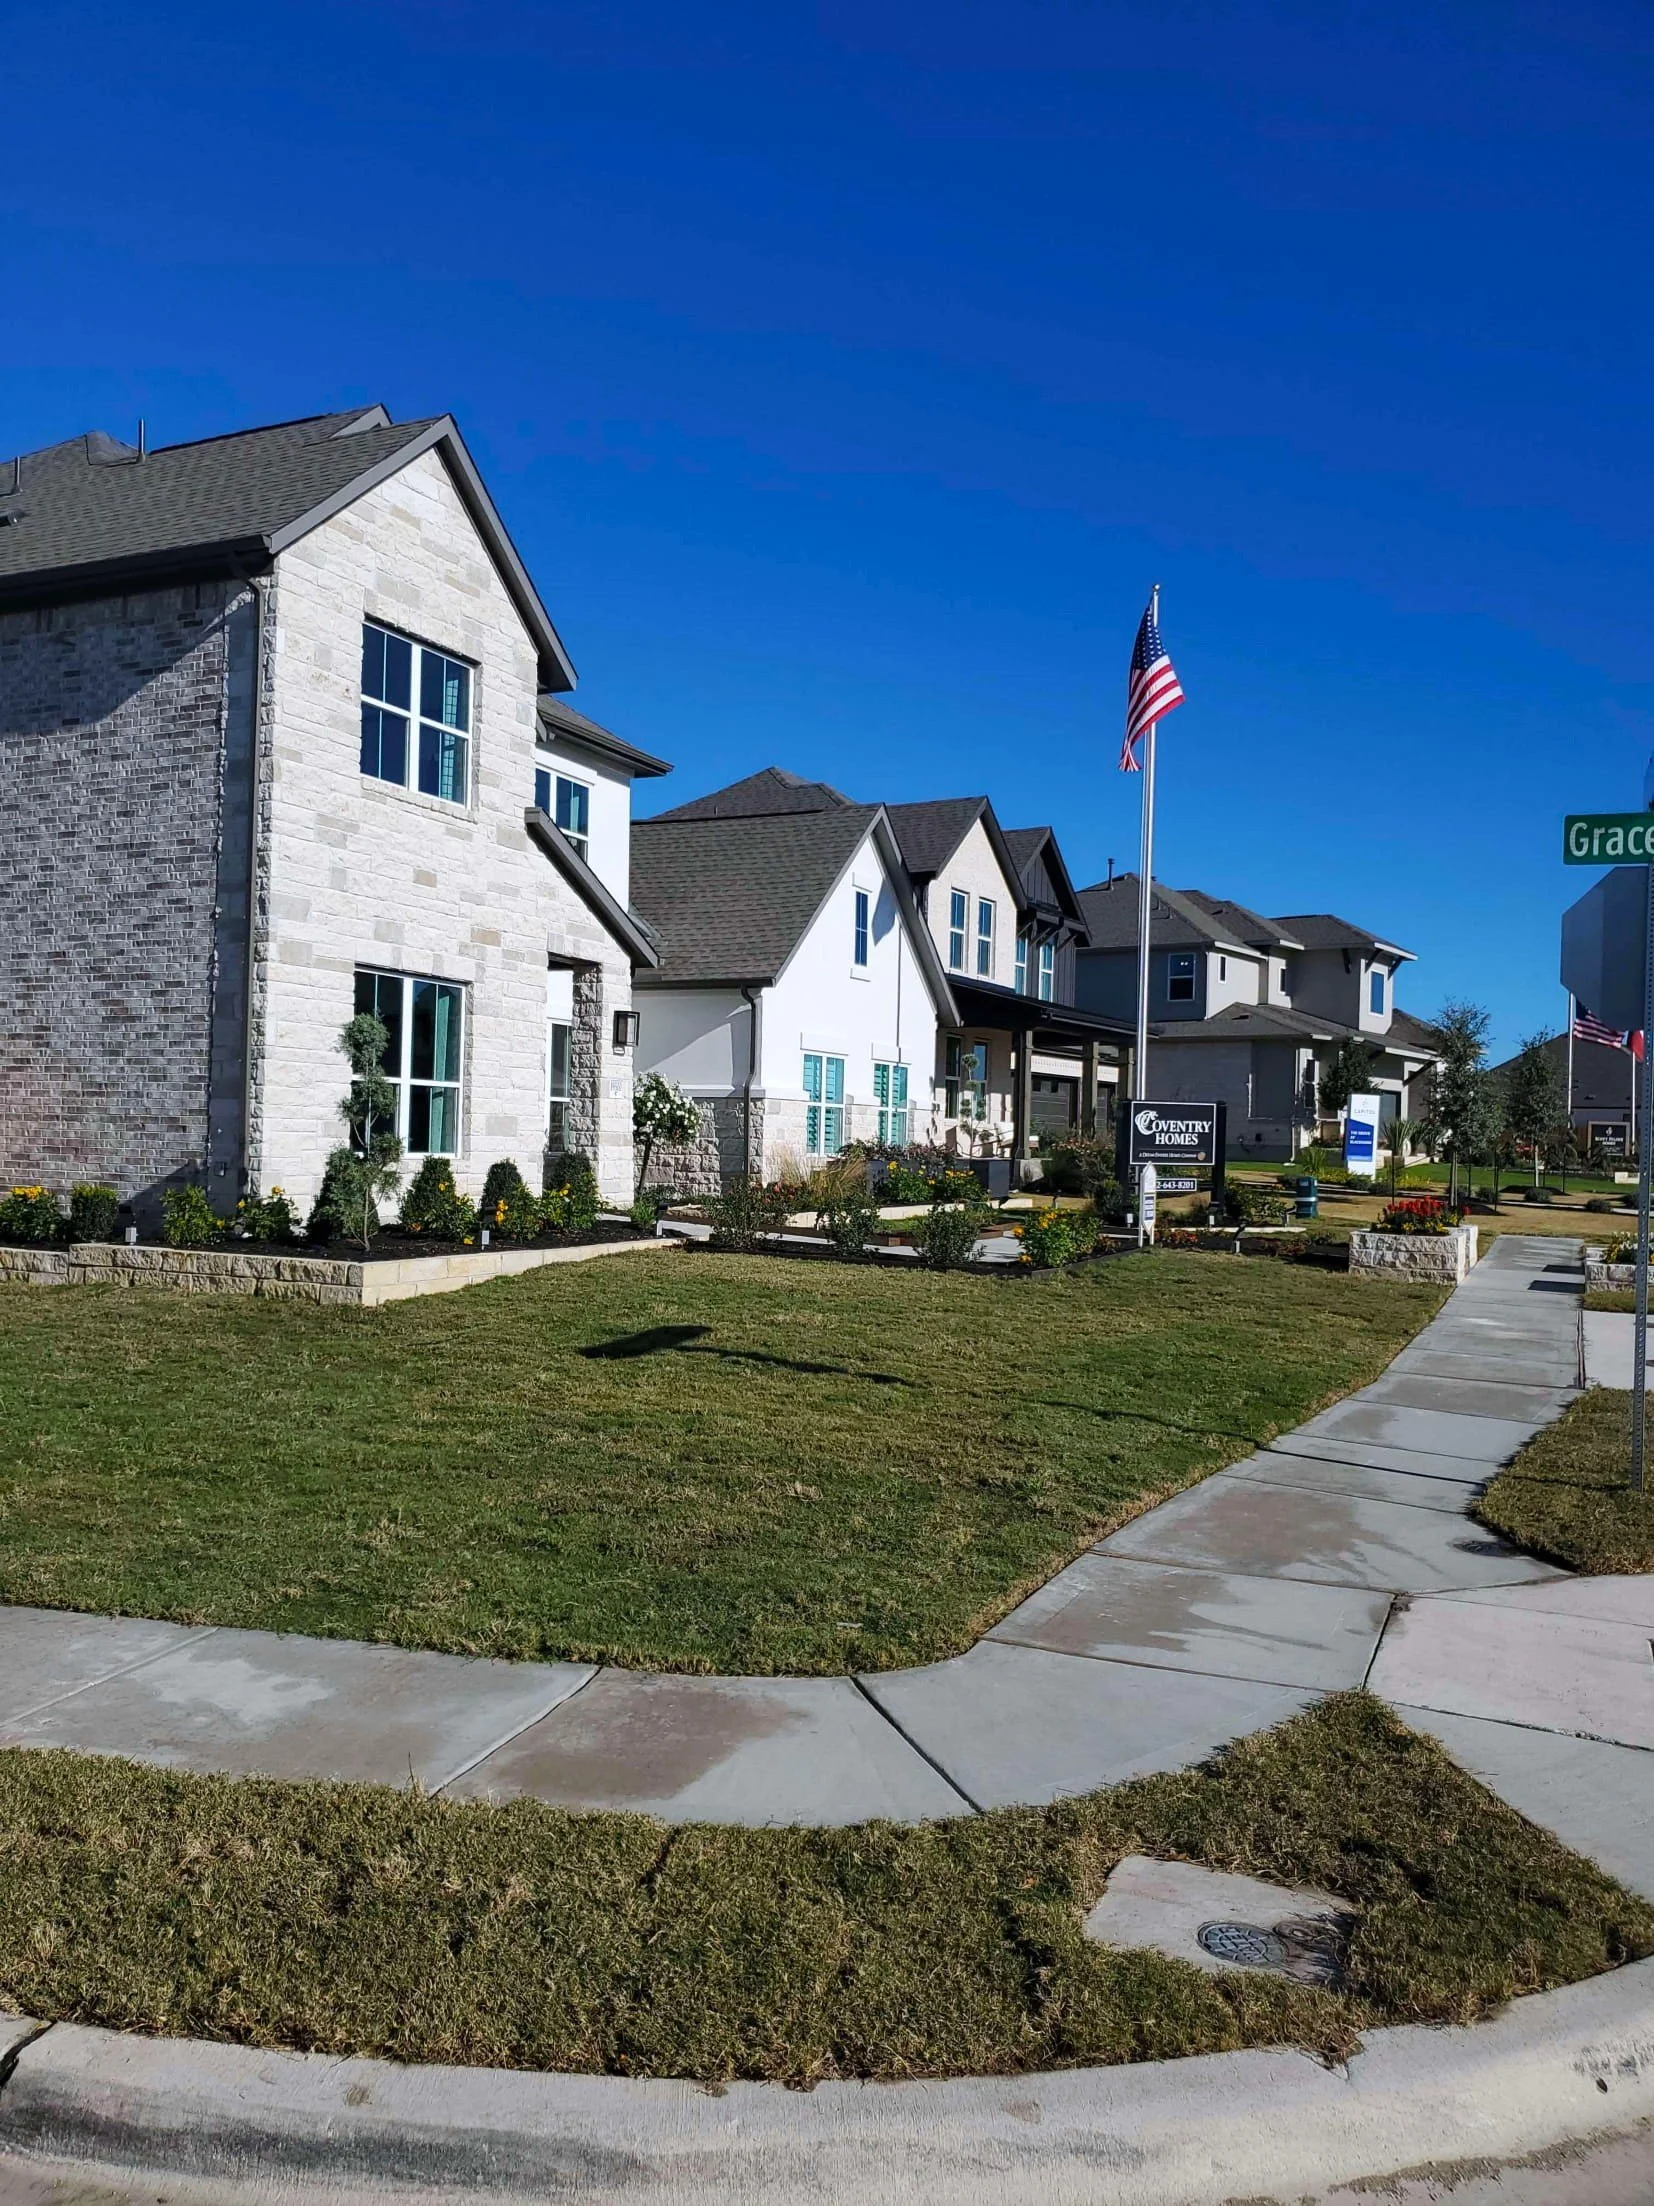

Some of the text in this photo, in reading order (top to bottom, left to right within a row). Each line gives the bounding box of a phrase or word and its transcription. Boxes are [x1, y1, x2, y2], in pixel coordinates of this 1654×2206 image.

[1569, 822, 1654, 857] Grace
[1135, 1109, 1212, 1135] COVENTRY
[1155, 1132, 1199, 1146] HOMES
[1156, 1181, 1194, 1190] 2-643-8201
